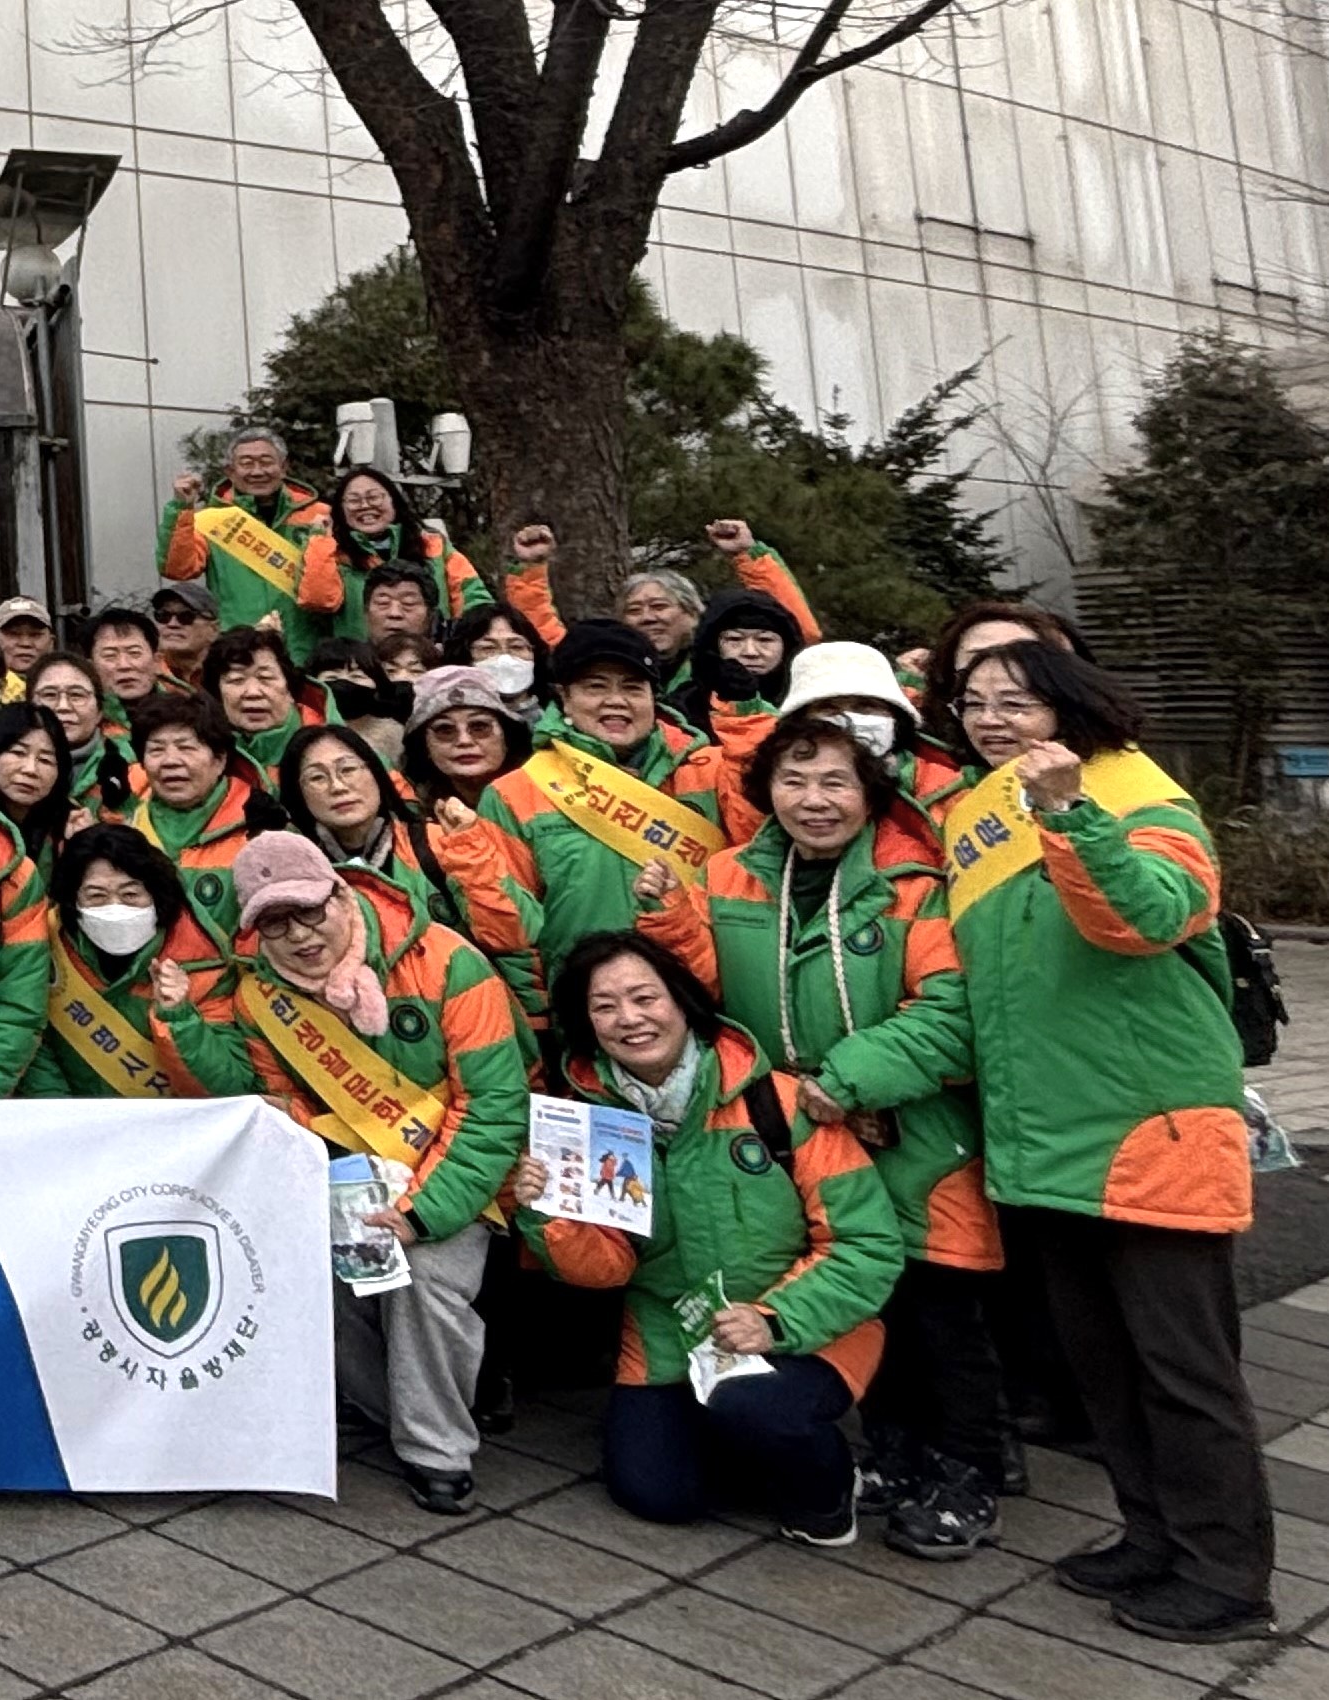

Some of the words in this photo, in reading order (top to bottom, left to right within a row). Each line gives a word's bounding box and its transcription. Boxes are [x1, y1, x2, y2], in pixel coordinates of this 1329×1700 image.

[947, 811, 1011, 887] 광명
[119, 1185, 148, 1203] CITY
[229, 1219, 243, 1236] IN
